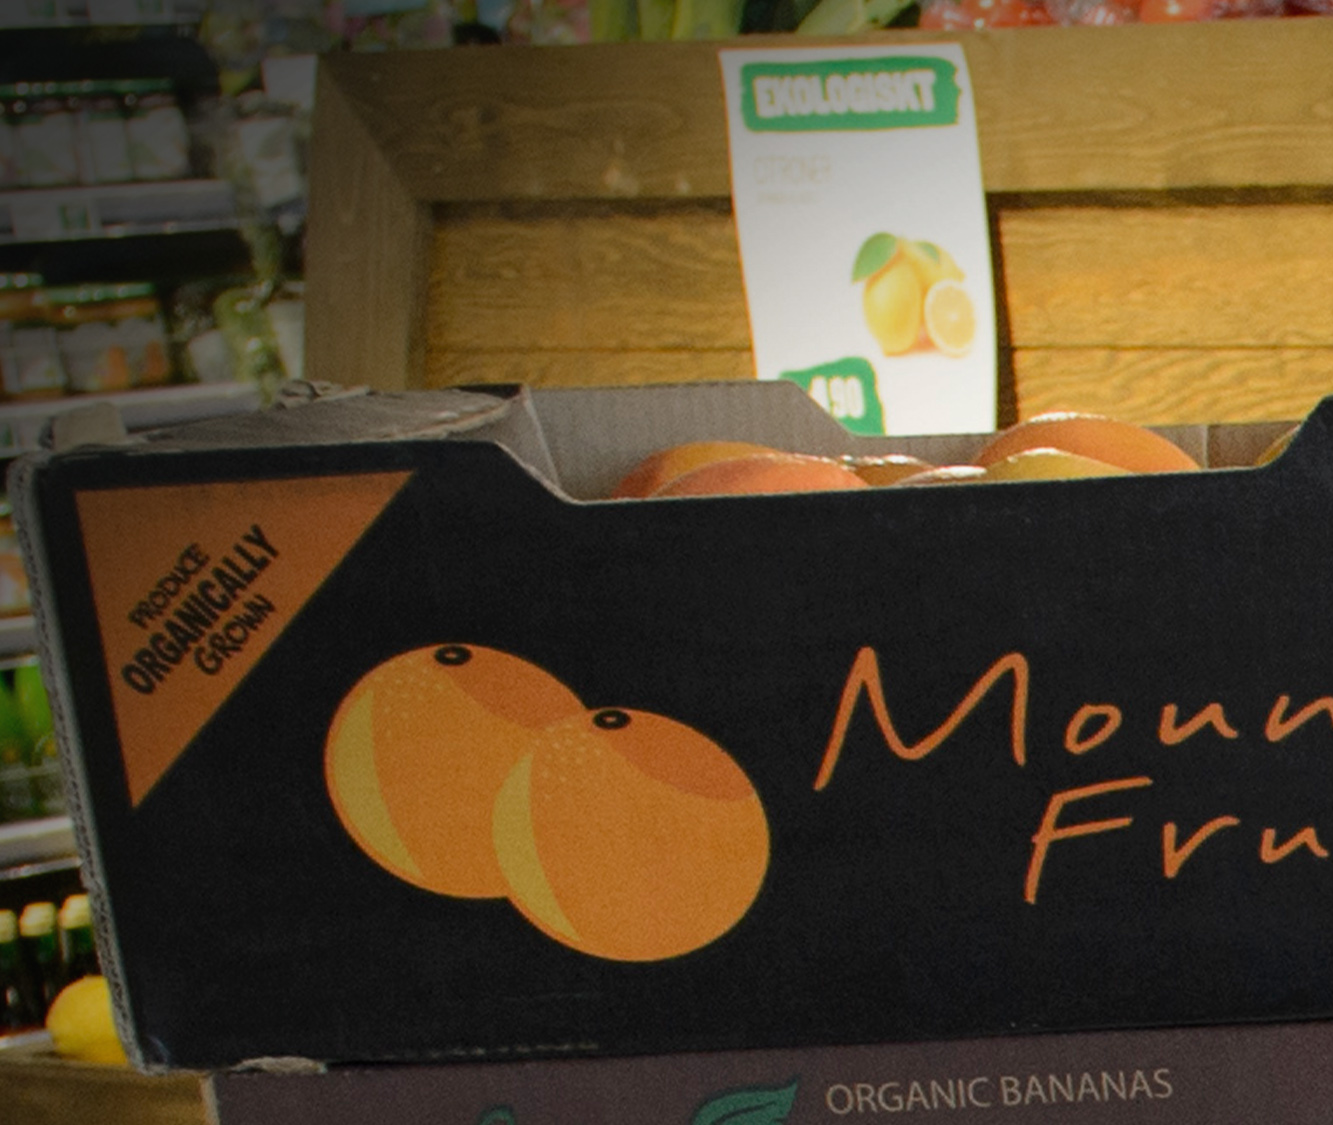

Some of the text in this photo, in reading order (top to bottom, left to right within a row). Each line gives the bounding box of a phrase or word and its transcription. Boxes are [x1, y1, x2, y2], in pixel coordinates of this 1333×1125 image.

[754, 69, 937, 119] EKOLOGISKT
[121, 523, 279, 695] ORGANICALLY
[127, 542, 210, 629] PRODUCE
[194, 594, 276, 676] GROWN
[826, 1068, 1174, 1116] ORGANIC BANANAS
